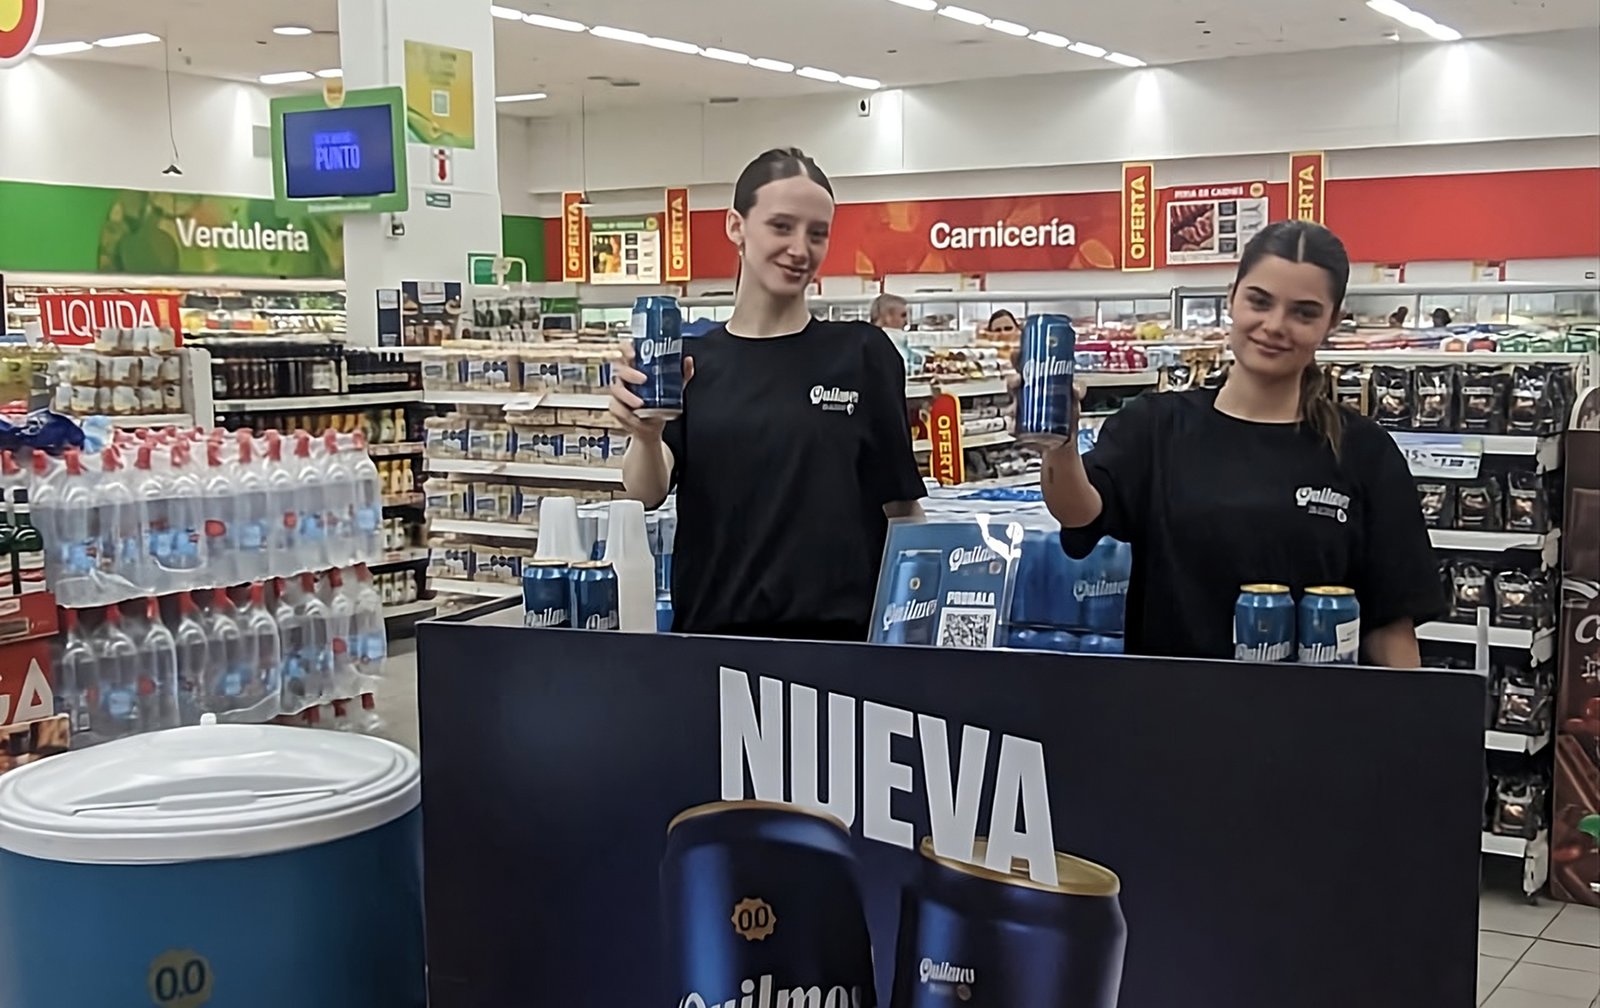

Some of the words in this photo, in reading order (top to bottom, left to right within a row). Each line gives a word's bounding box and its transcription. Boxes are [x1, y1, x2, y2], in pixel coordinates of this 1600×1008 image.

[1130, 175, 1146, 260] OFERTA
[1298, 165, 1315, 222] ERTA
[567, 203, 580, 272] OFERTA
[671, 197, 684, 270] OFERTA
[930, 217, 1076, 249] Carnicería
[719, 666, 1059, 887] NUEVA
